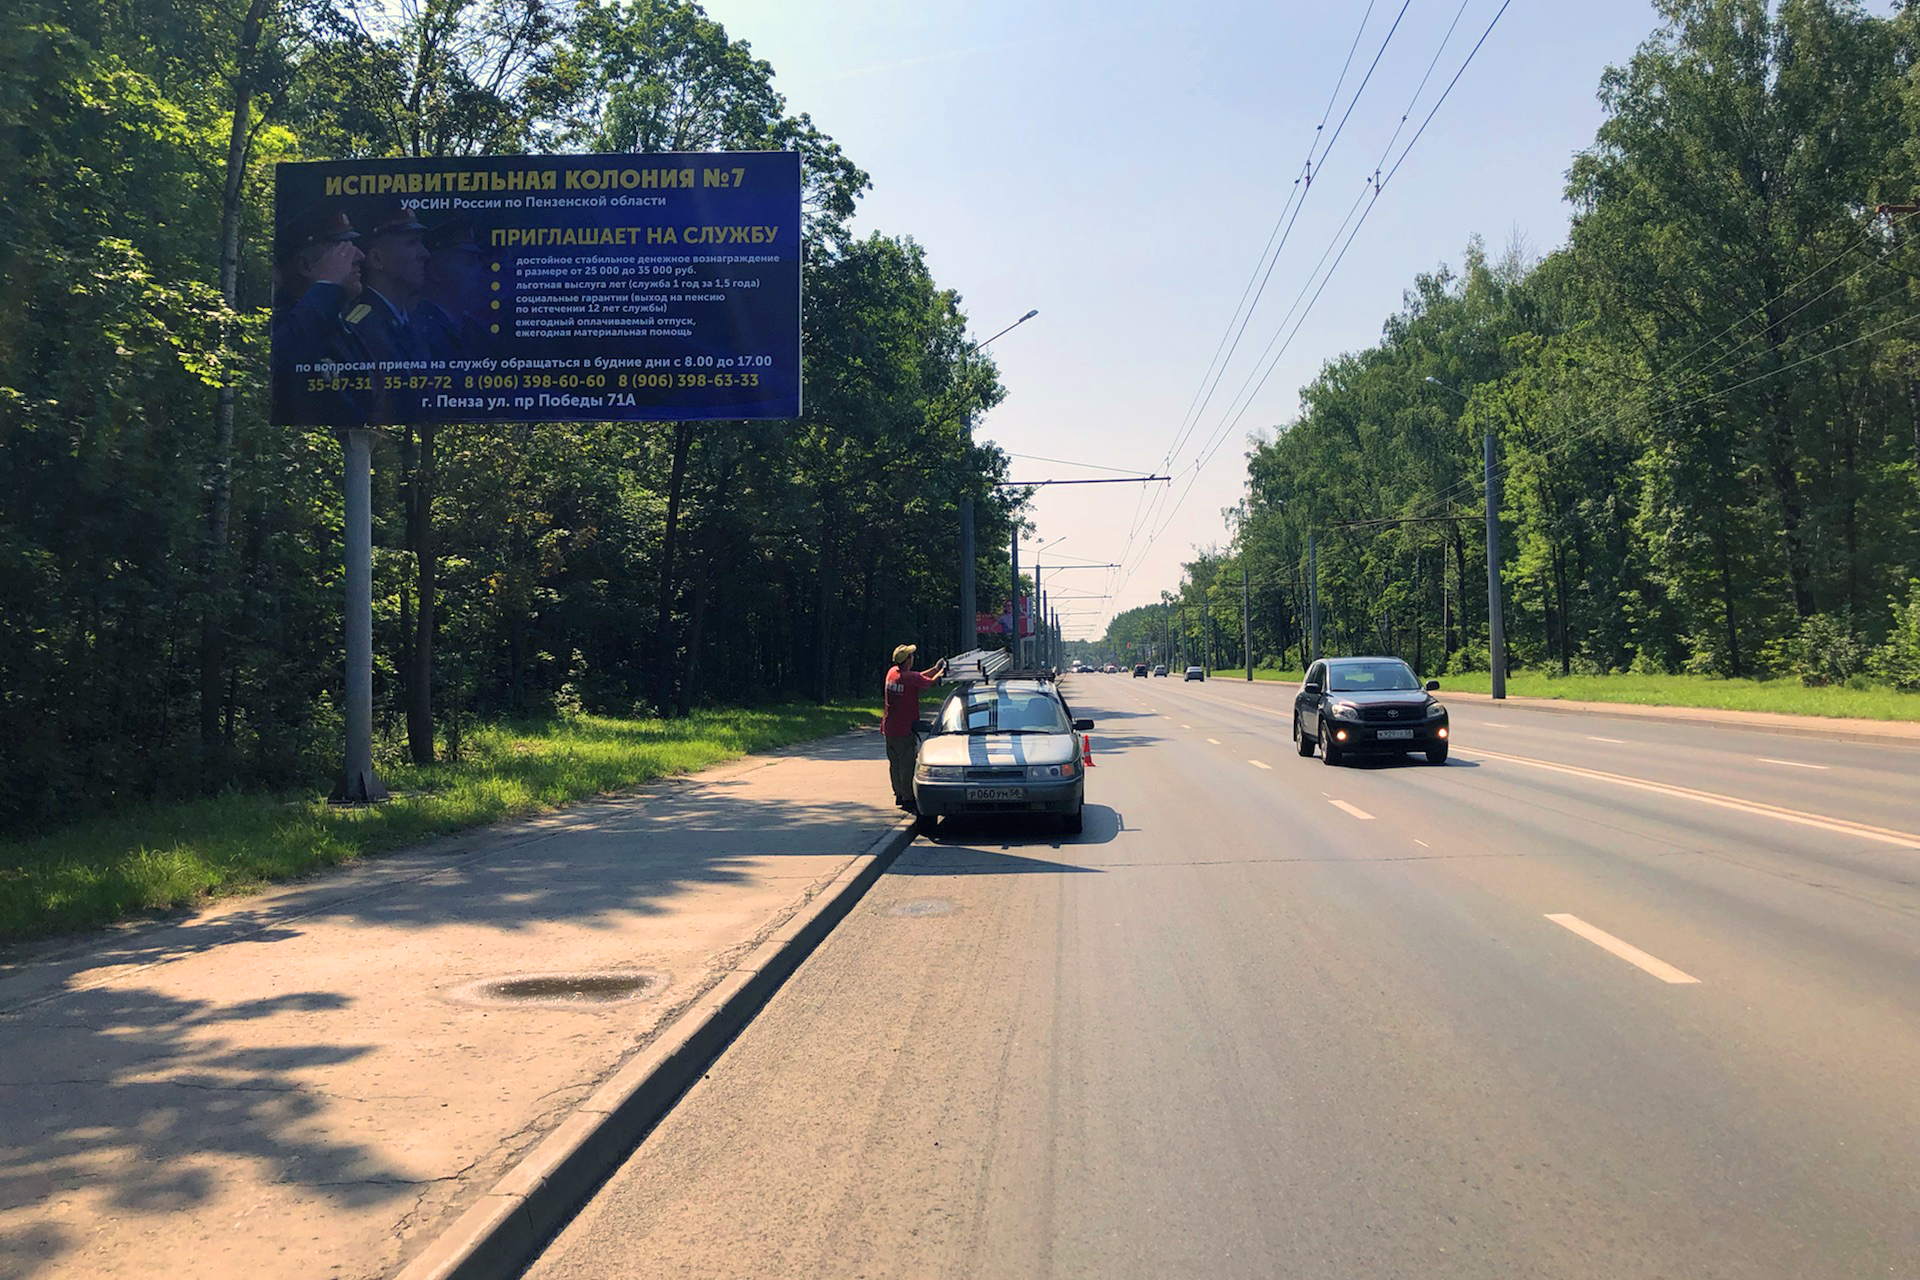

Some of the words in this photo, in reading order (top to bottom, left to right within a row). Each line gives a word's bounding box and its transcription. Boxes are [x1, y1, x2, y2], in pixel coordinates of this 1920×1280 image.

[325, 170, 556, 196] ИСПРАВИТЕЛЬНАЯ
[565, 168, 694, 189] КОЛОНИЯ
[703, 167, 745, 188] №7
[400, 198, 449, 210] УФСИН
[453, 198, 501, 210] России
[505, 199, 522, 208] по
[525, 196, 607, 208] Пензенской
[610, 195, 666, 207] области
[491, 227, 640, 247] ПРИГЛАШАЕТ
[647, 227, 677, 245] НА
[683, 225, 778, 244] СЛУЖБУ
[516, 255, 572, 266] достойное
[575, 254, 635, 264] стабильное
[637, 255, 690, 265] денежное
[693, 254, 780, 265] вознаграждение
[516, 268, 522, 276] в
[525, 268, 568, 278] размере
[570, 268, 583, 276] от
[585, 266, 597, 275] 25
[599, 266, 619, 275] 000
[622, 267, 635, 276] до
[638, 265, 650, 274] 35
[652, 265, 672, 274] 000
[675, 265, 697, 277] руб.
[516, 281, 562, 290] льготная
[564, 281, 606, 291] выслуга
[609, 280, 626, 288] лет
[629, 279, 670, 291] (служба
[673, 279, 679, 288] 1
[681, 280, 699, 289] год
[702, 280, 712, 288] за
[715, 278, 730, 289] 1,5
[732, 278, 760, 289] года)
[516, 294, 579, 304] социальные
[581, 294, 629, 304] гарантии
[631, 292, 668, 303] (выход
[670, 294, 682, 302] на
[685, 294, 725, 302] пенсию
[516, 306, 529, 314] по
[531, 305, 586, 313] истечении
[588, 304, 600, 312] 12
[602, 304, 620, 312] лет
[622, 303, 667, 314] службы)
[515, 317, 574, 327] ежегодный
[577, 316, 654, 326] оплачиваемый
[657, 317, 697, 327] отпуск,
[515, 329, 571, 338] ежегодная
[573, 328, 647, 338] материальная
[649, 328, 693, 337] помощь
[295, 363, 311, 373] по
[313, 361, 375, 373] вопросам
[379, 360, 427, 372] приема
[430, 360, 446, 369] на
[449, 357, 497, 371] службу
[501, 356, 580, 371] обращаться
[584, 359, 591, 367] в
[594, 356, 642, 370] будние
[645, 357, 671, 369] дни
[673, 358, 681, 367] с
[684, 355, 713, 367] 8.00
[716, 357, 734, 368] до
[737, 355, 772, 367] 17.00
[307, 377, 372, 392] 35-87-31
[384, 375, 452, 389] 35-87-72
[464, 375, 474, 389] 8
[478, 374, 518, 391] (906)
[523, 374, 606, 389] 398-60-60
[618, 374, 627, 387] 8
[632, 373, 673, 388] (906)
[677, 373, 759, 387] 398-63-33
[421, 397, 432, 408] г.
[436, 395, 483, 408] Пенза
[487, 396, 510, 411] ул.
[514, 396, 534, 410] пр
[539, 393, 603, 408] Победы
[607, 392, 636, 406] 71А
